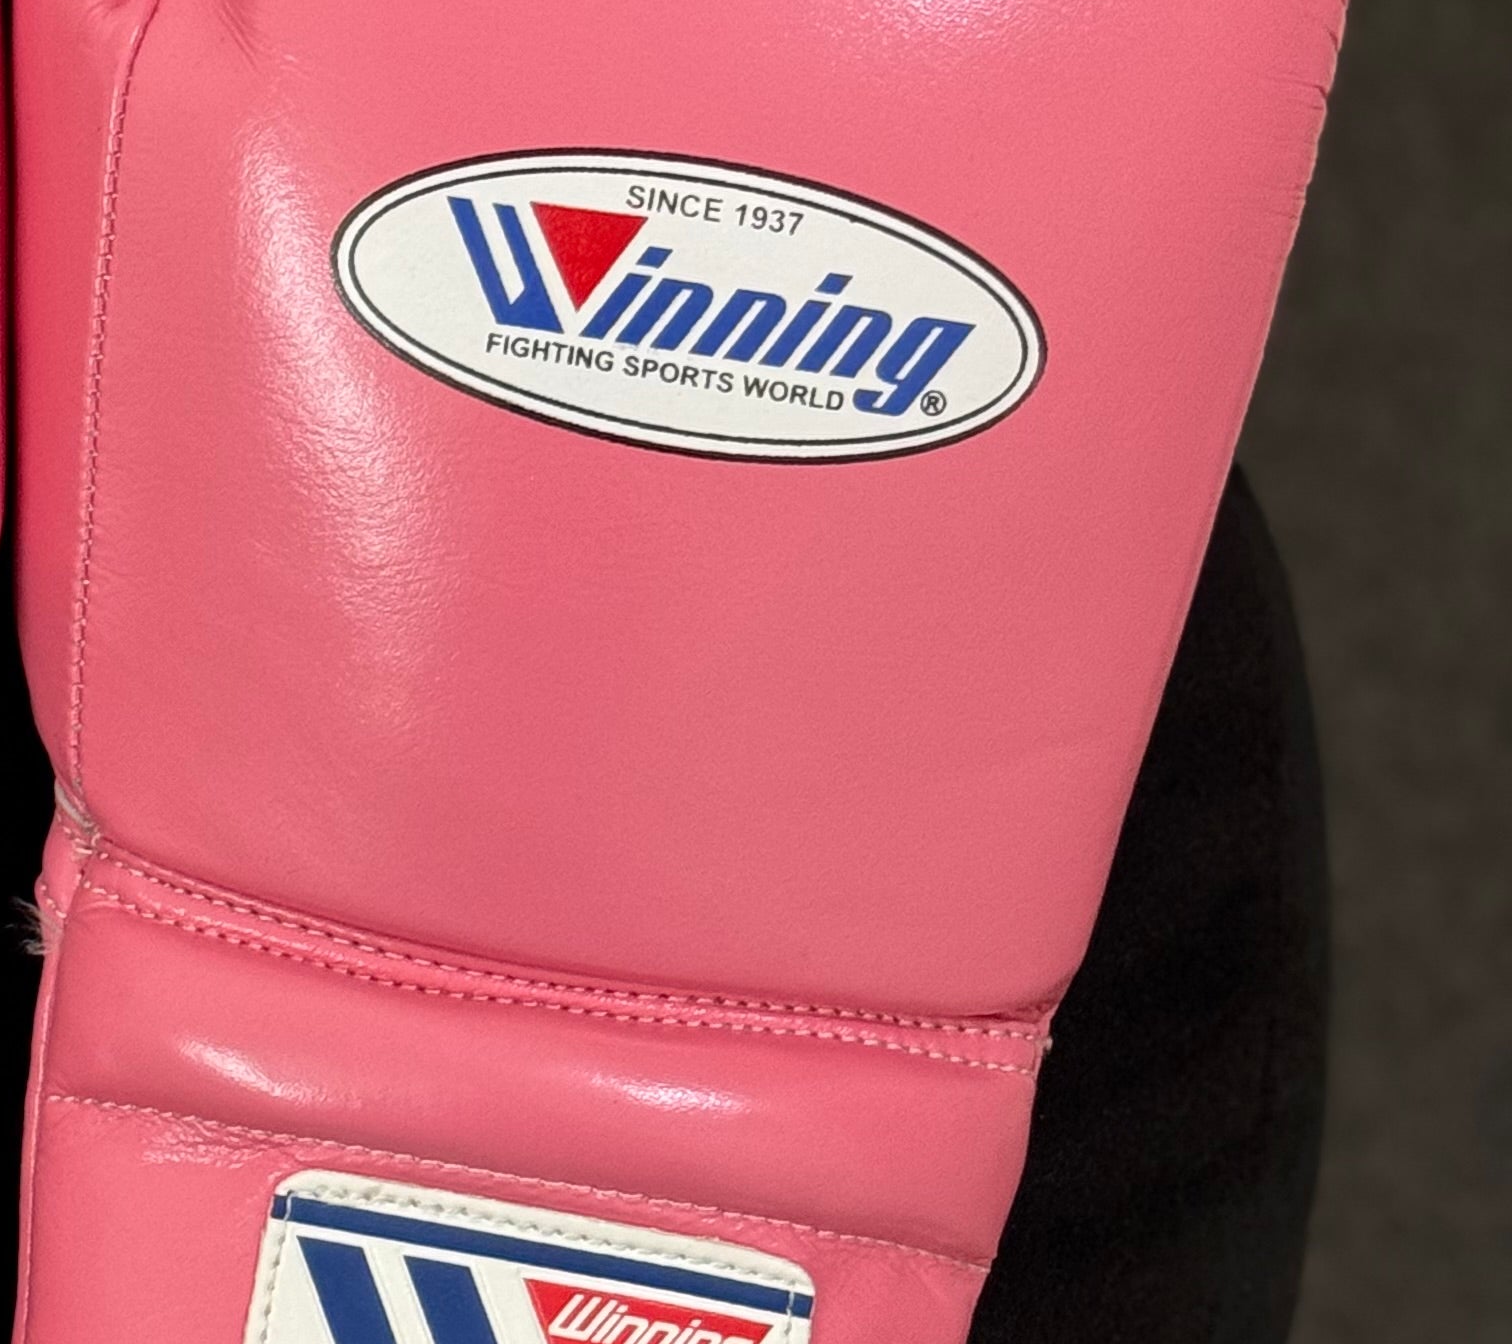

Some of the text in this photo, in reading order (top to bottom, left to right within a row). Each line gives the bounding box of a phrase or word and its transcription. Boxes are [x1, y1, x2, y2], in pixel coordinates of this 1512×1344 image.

[625, 184, 805, 237] SINCE 1937
[447, 195, 977, 417] Winning
[486, 331, 845, 412] FIGHTING SPORTS WORLD
